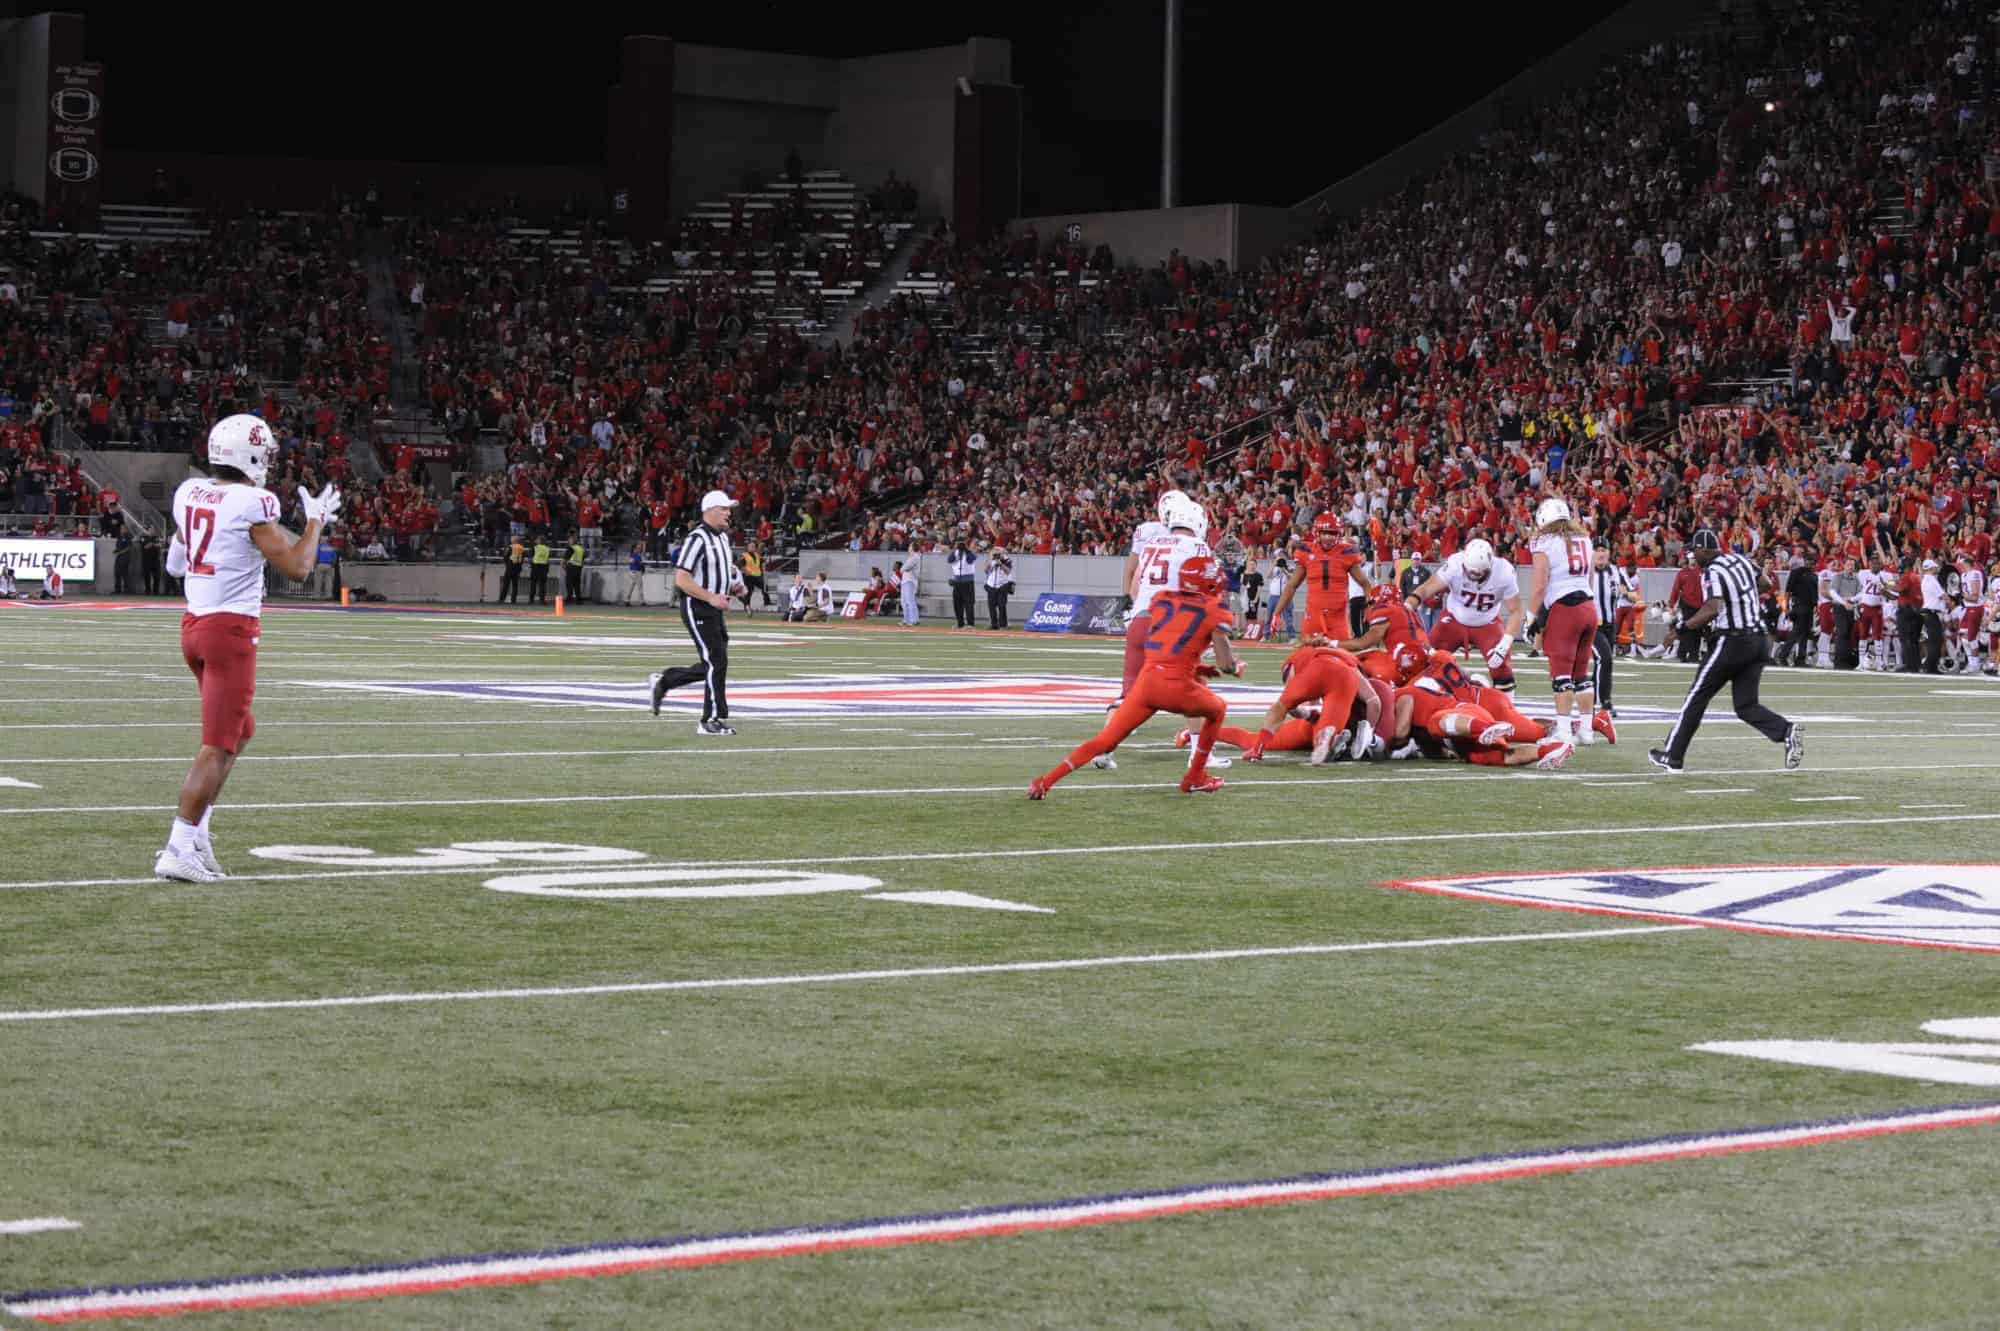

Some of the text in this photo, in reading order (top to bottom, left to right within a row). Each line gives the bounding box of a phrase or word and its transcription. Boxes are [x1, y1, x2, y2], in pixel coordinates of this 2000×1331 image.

[259, 495, 277, 519] 12
[185, 505, 216, 576] 12
[0, 551, 88, 568] ATHLETICS
[1140, 546, 1172, 585] 75
[1567, 540, 1588, 575] 61
[1322, 559, 1329, 590] 1
[846, 603, 858, 617] G
[1044, 600, 1073, 614] Game
[1460, 590, 1496, 612] 76
[1031, 610, 1073, 625] Sponsor
[1144, 600, 1207, 654] 27
